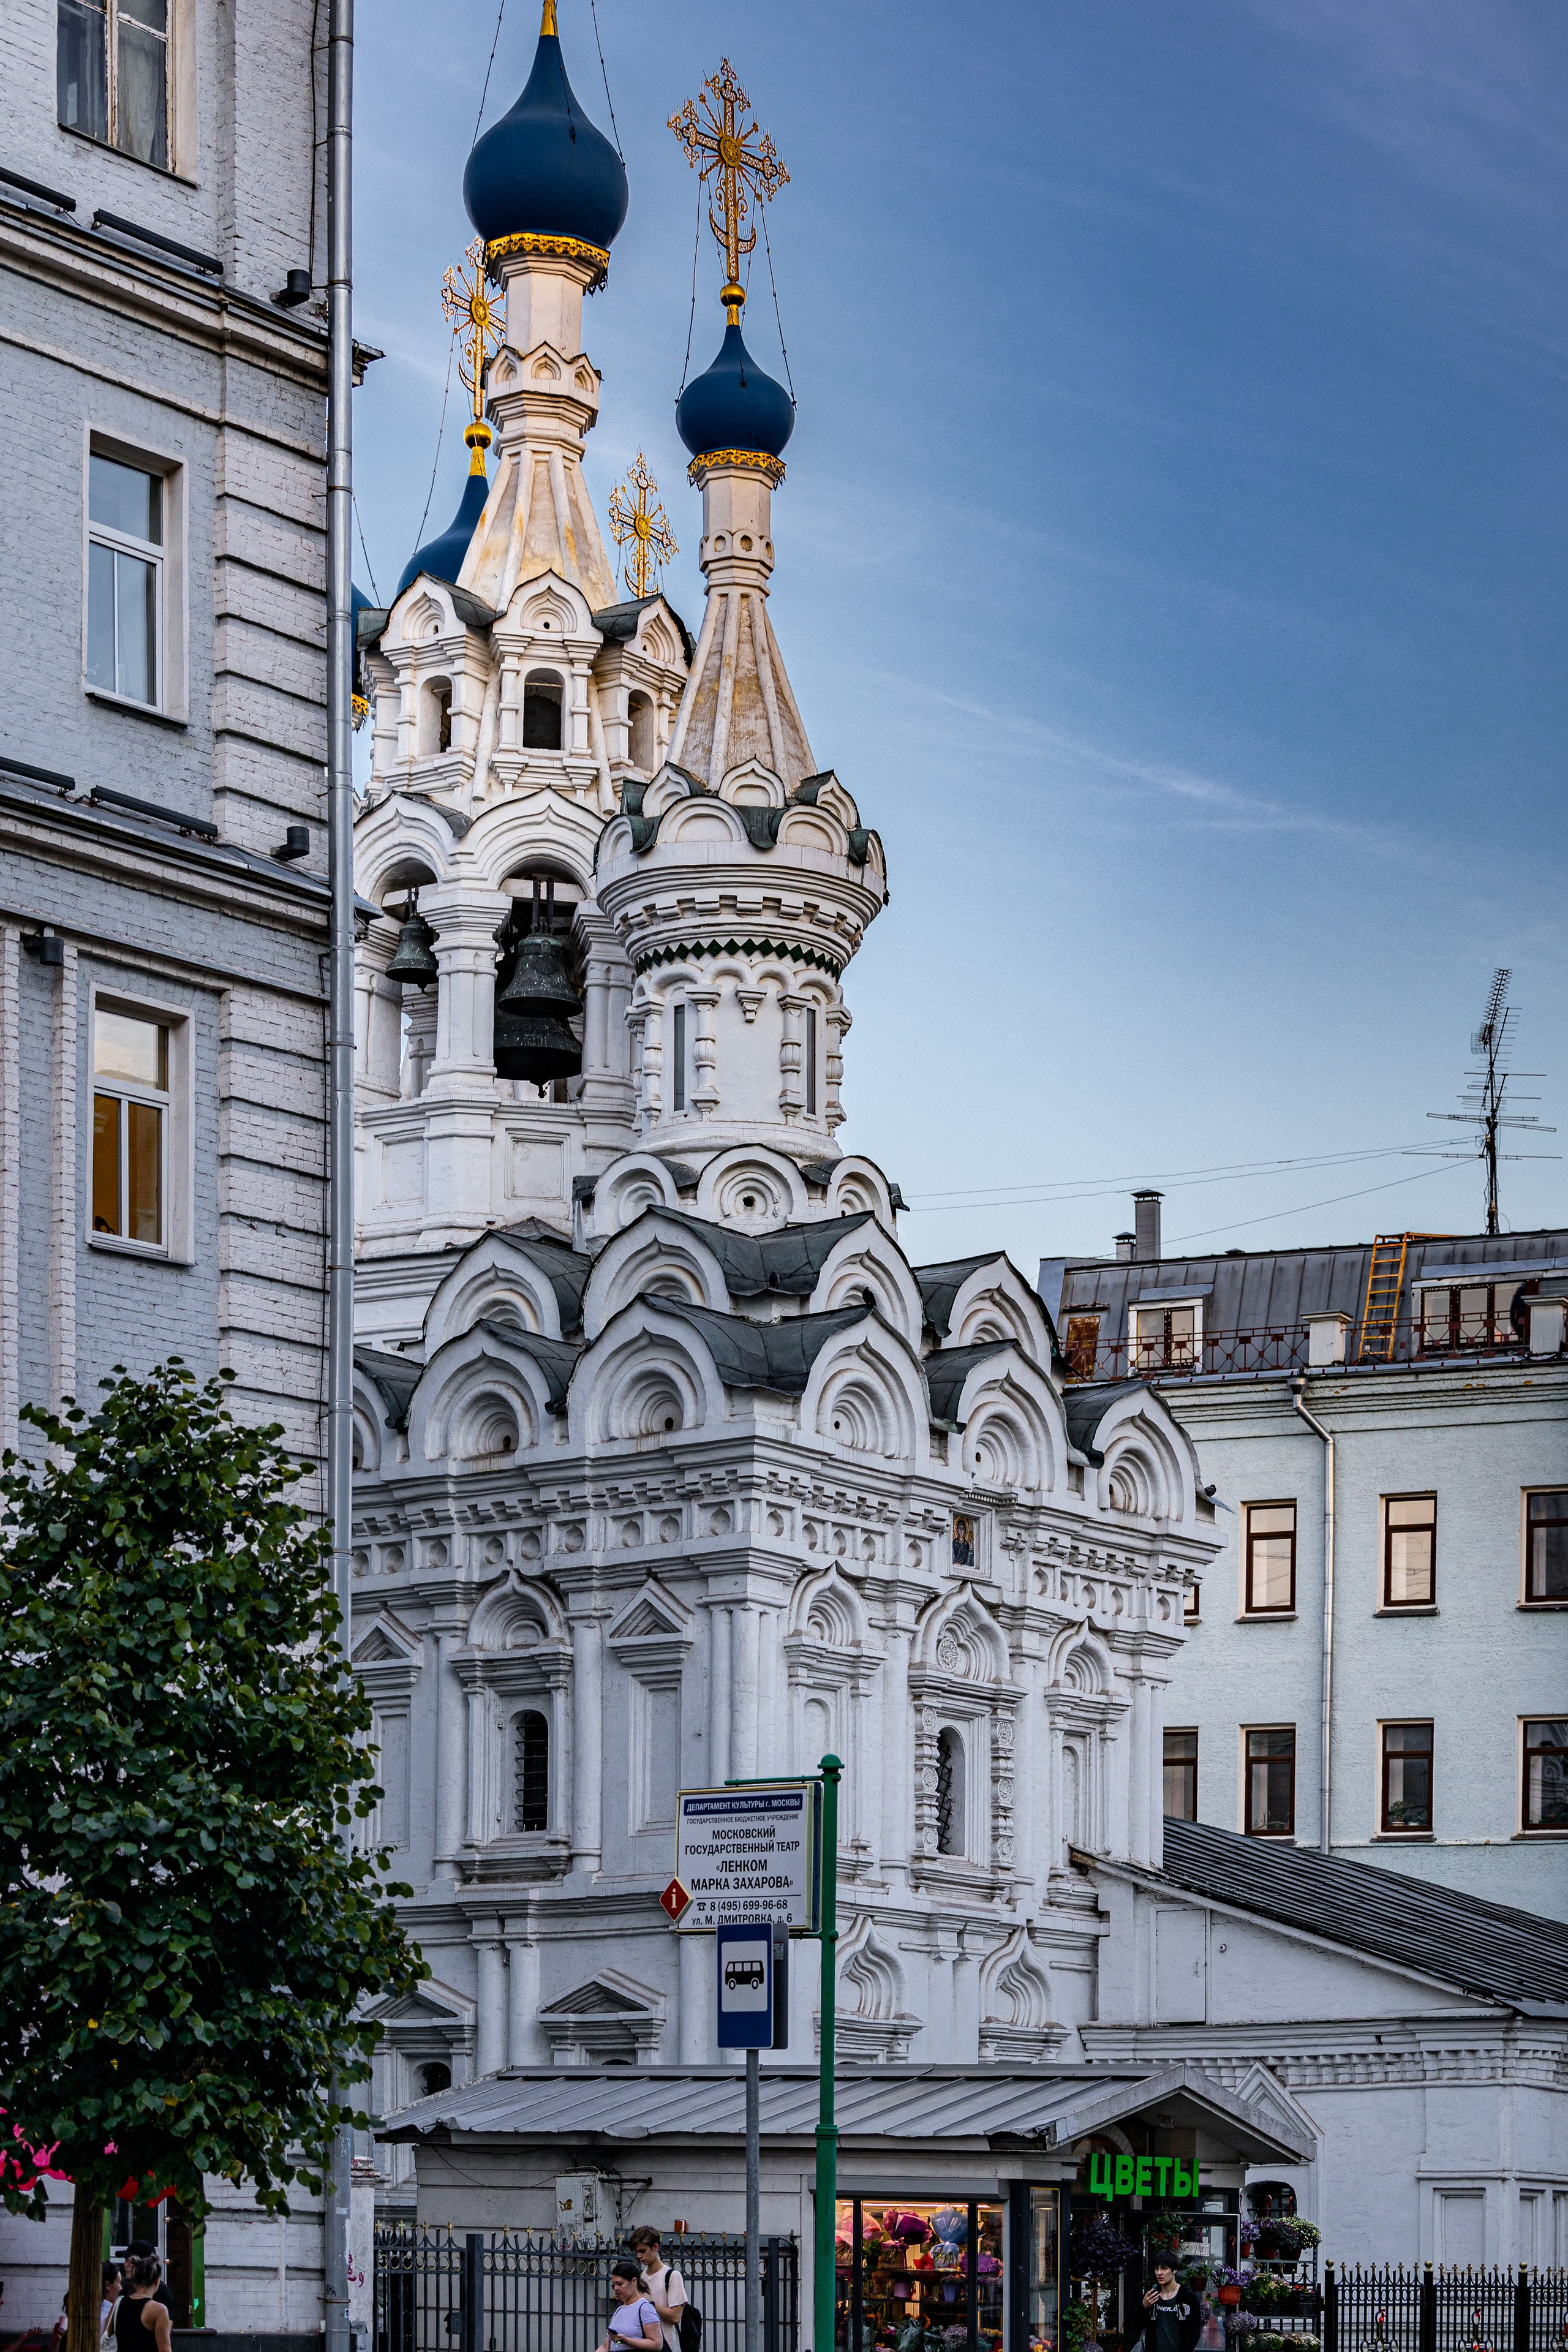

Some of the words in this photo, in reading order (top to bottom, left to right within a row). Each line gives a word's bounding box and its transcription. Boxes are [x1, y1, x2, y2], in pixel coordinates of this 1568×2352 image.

[687, 1802, 730, 1812] ДЕПАРТАМЕНТ
[731, 1800, 764, 1809] КУЛЬТУРЫ
[771, 1798, 800, 1807] МОСКВЫ
[712, 1825, 775, 1840] МОСКОВСКИЙ
[685, 1839, 774, 1856] ГОСУДАРСТВЕННЫЙ
[776, 1841, 800, 1852] ТЕАТР
[715, 1859, 767, 1872] «ЛЕНКОМ
[691, 1877, 730, 1891] МАРКА
[733, 1875, 793, 1890] ЗАХАРОВА»
[710, 1901, 716, 1911] 8
[717, 1900, 741, 1912] (495)
[742, 1899, 788, 1910] 699-96-68
[705, 1915, 715, 1924] М.
[717, 1913, 775, 1924] ДМИТРОВКА,
[786, 1913, 793, 1923] 6
[1090, 2153, 1199, 2201] ЦВЕТЫ
